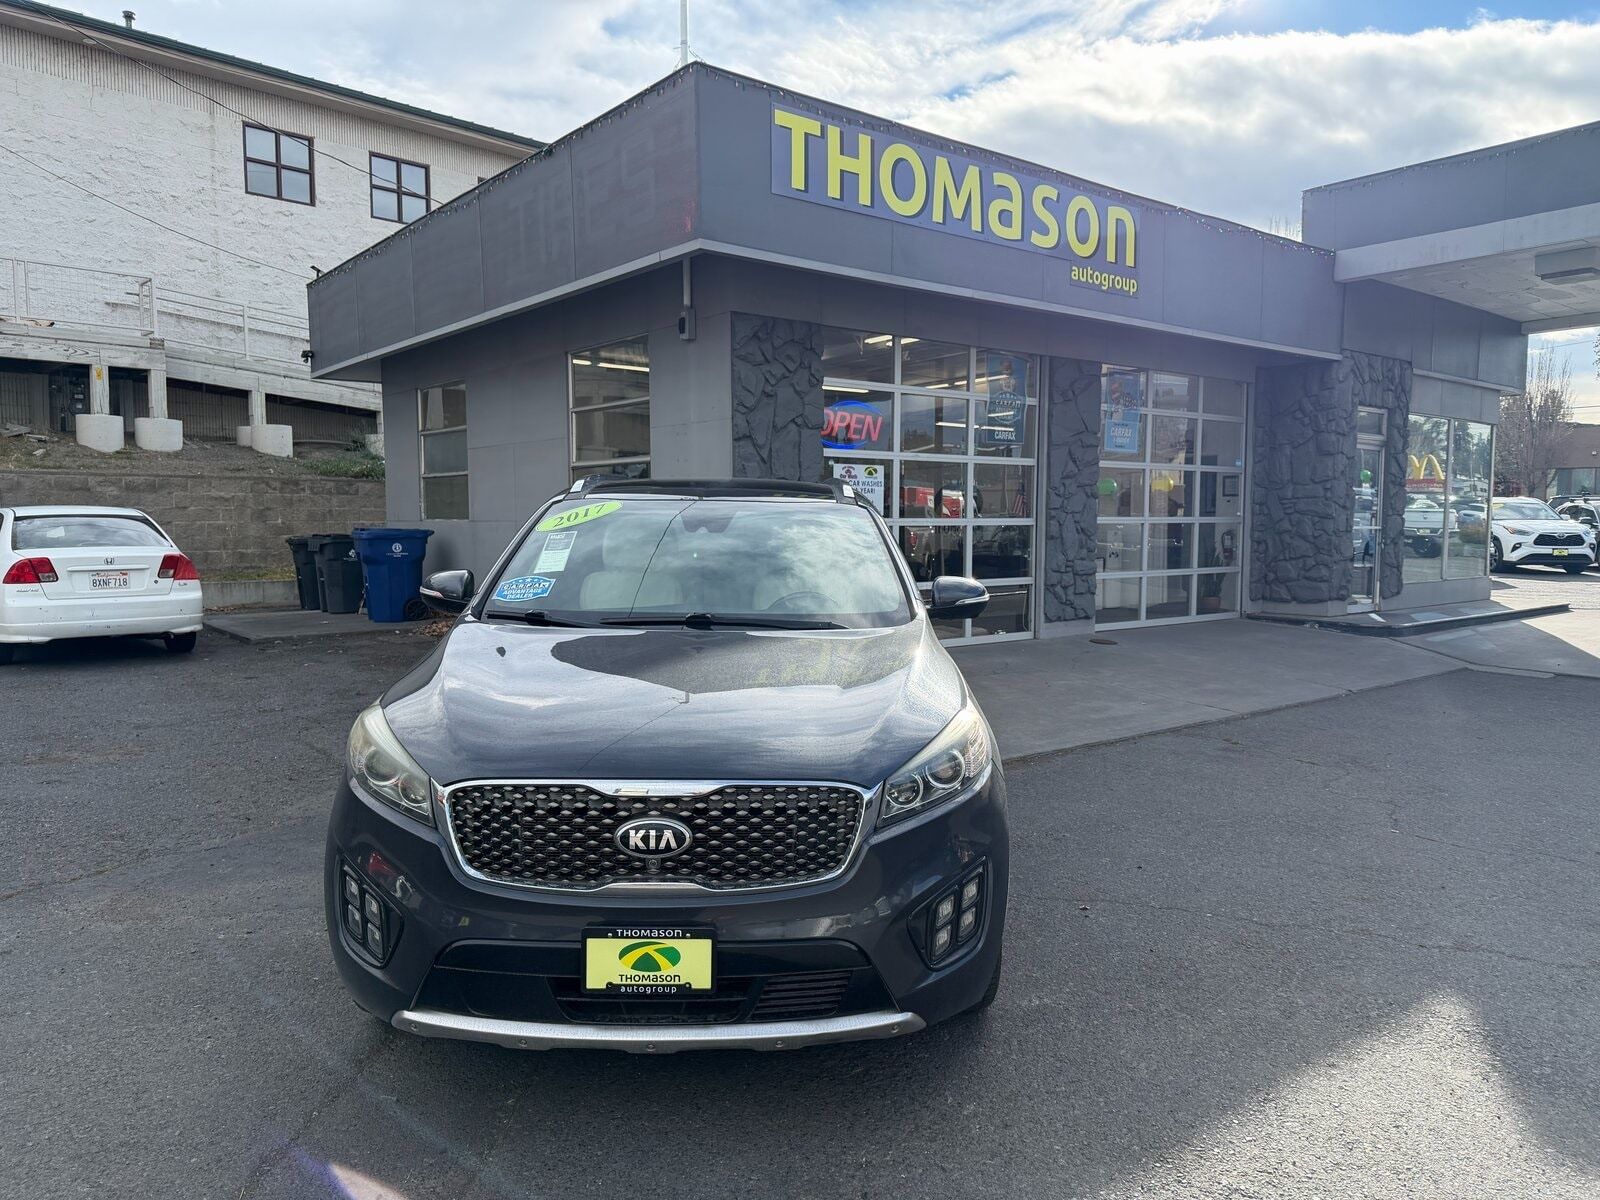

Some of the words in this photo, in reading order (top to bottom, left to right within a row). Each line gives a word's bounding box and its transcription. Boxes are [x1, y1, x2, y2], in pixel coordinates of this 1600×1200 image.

[1070, 264, 1138, 296] autogroup
[821, 407, 883, 442] OPEN
[994, 431, 1016, 441] CARFAX
[553, 503, 606, 528] 2017
[92, 577, 128, 588] 8XNF718
[503, 582, 550, 590] CARFAX
[628, 829, 678, 850] KIA
[620, 985, 677, 994] autogroup
